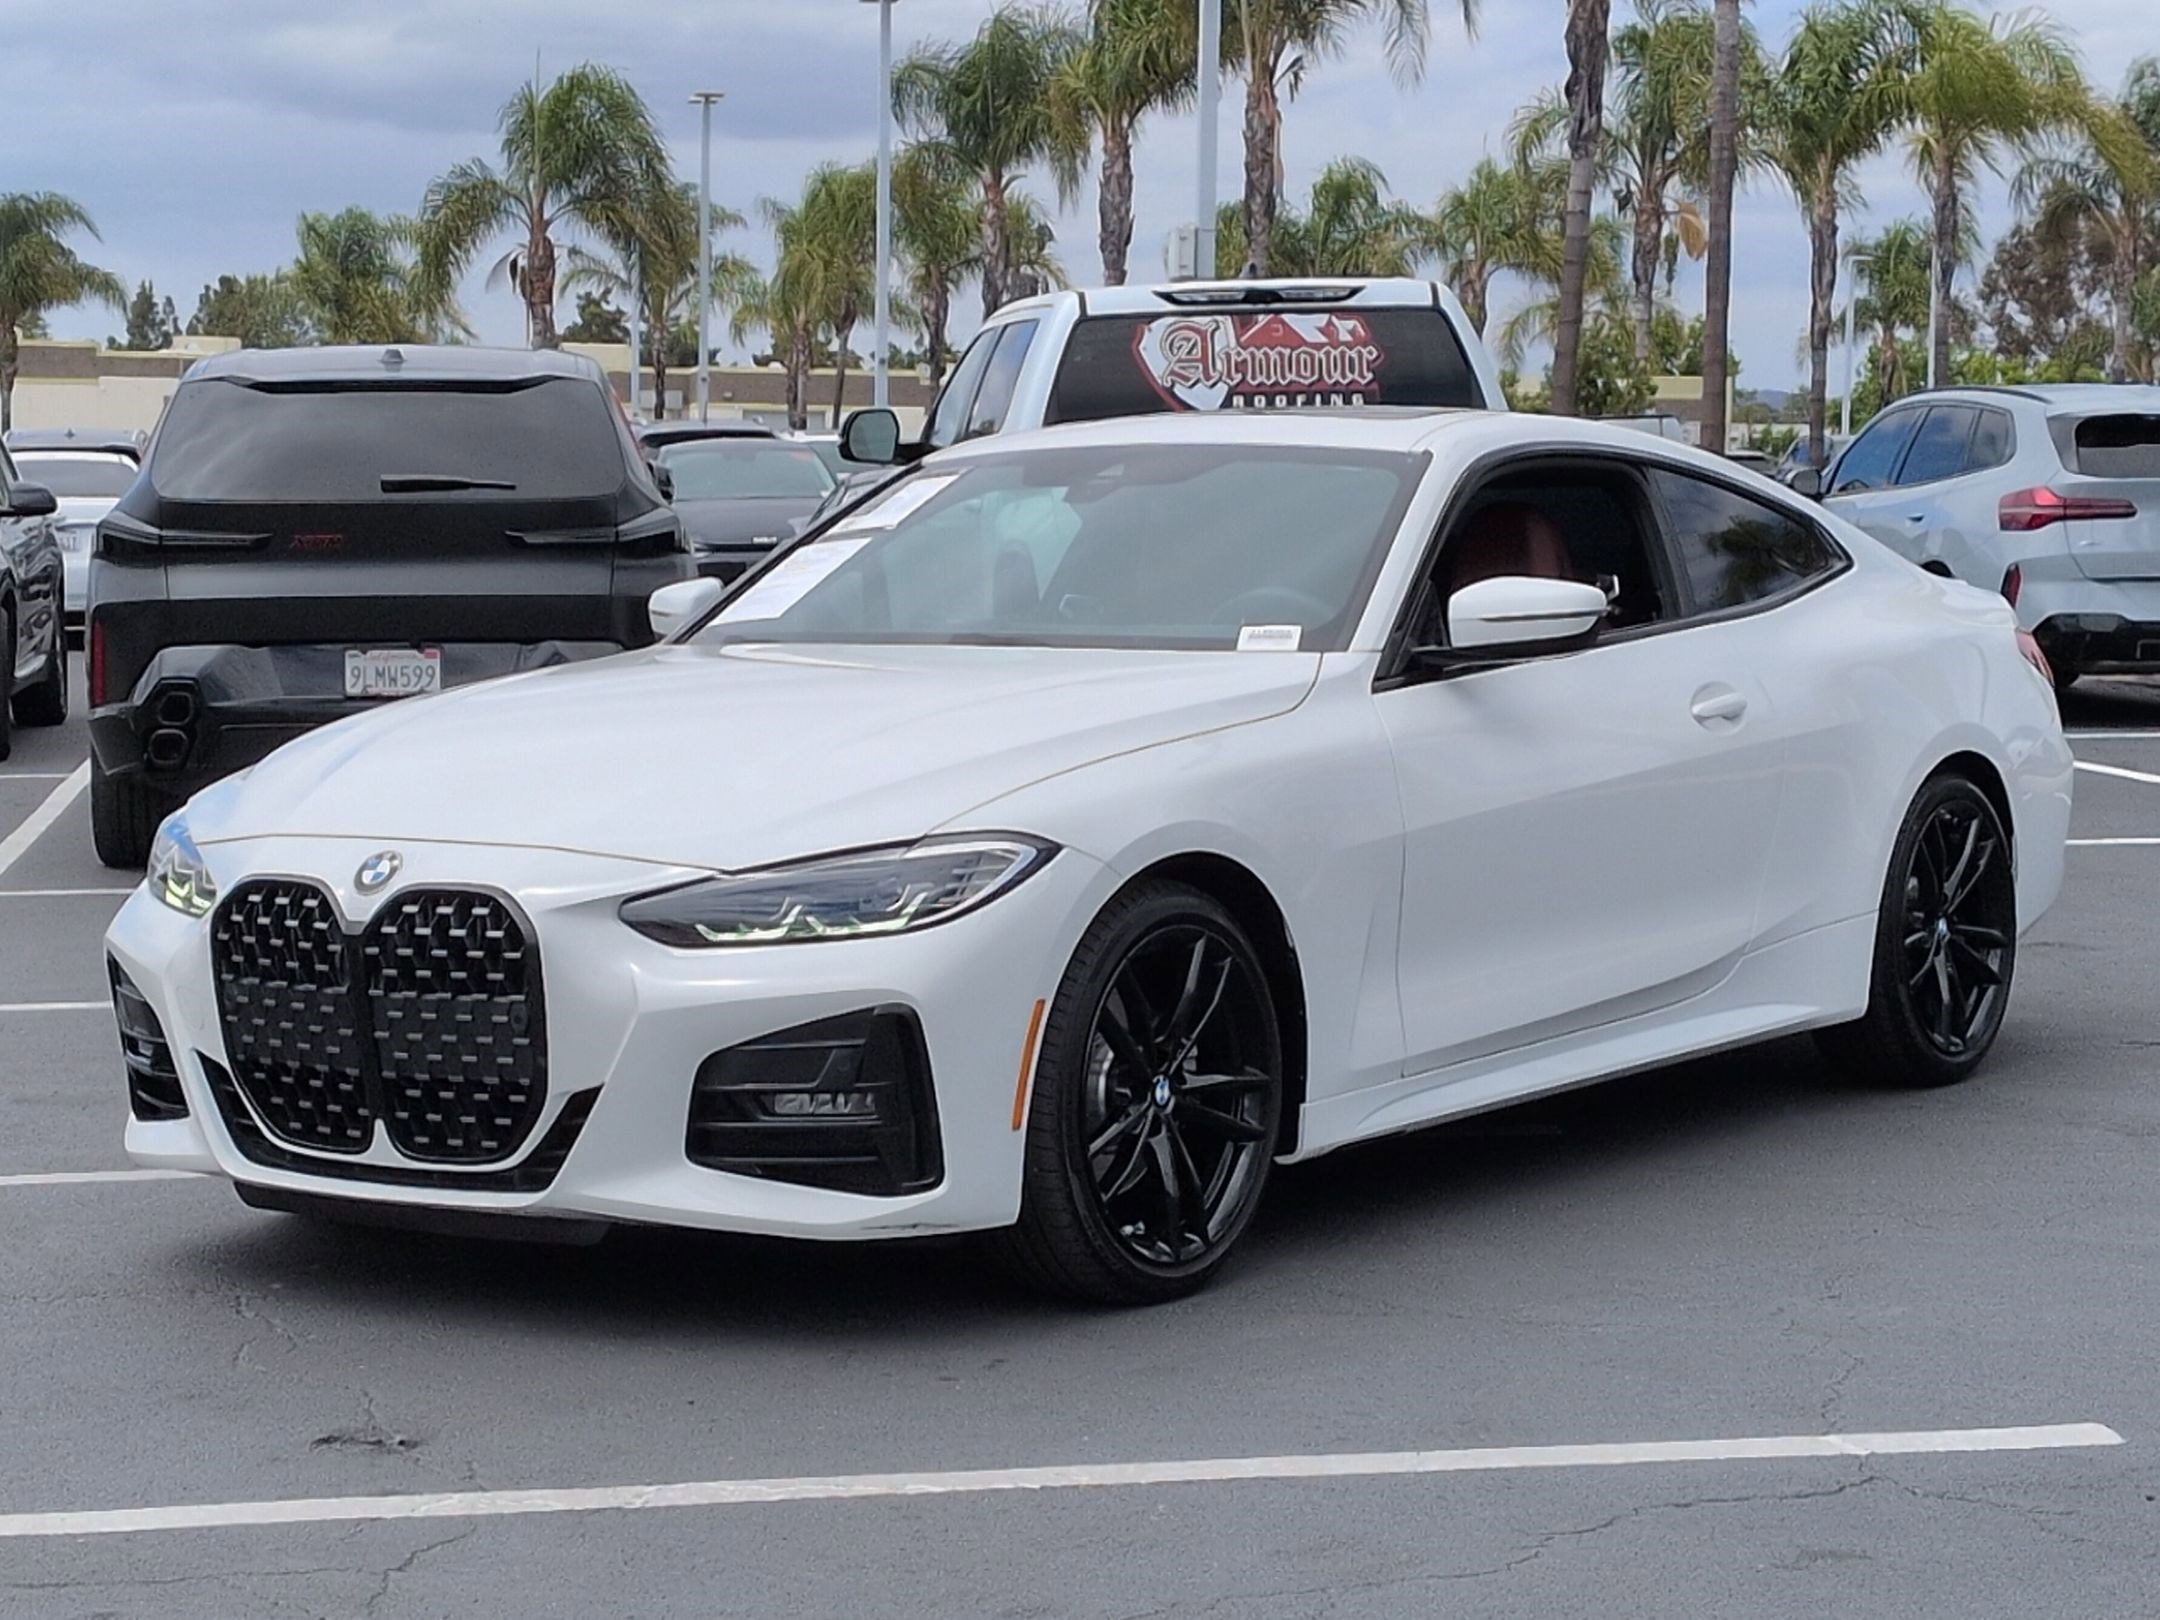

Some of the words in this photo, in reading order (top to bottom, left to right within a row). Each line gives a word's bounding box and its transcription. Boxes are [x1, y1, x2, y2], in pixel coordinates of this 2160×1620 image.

[1161, 320, 1378, 388] Armour
[1232, 394, 1365, 407] ROOFING
[350, 665, 436, 688] 9LMW599
